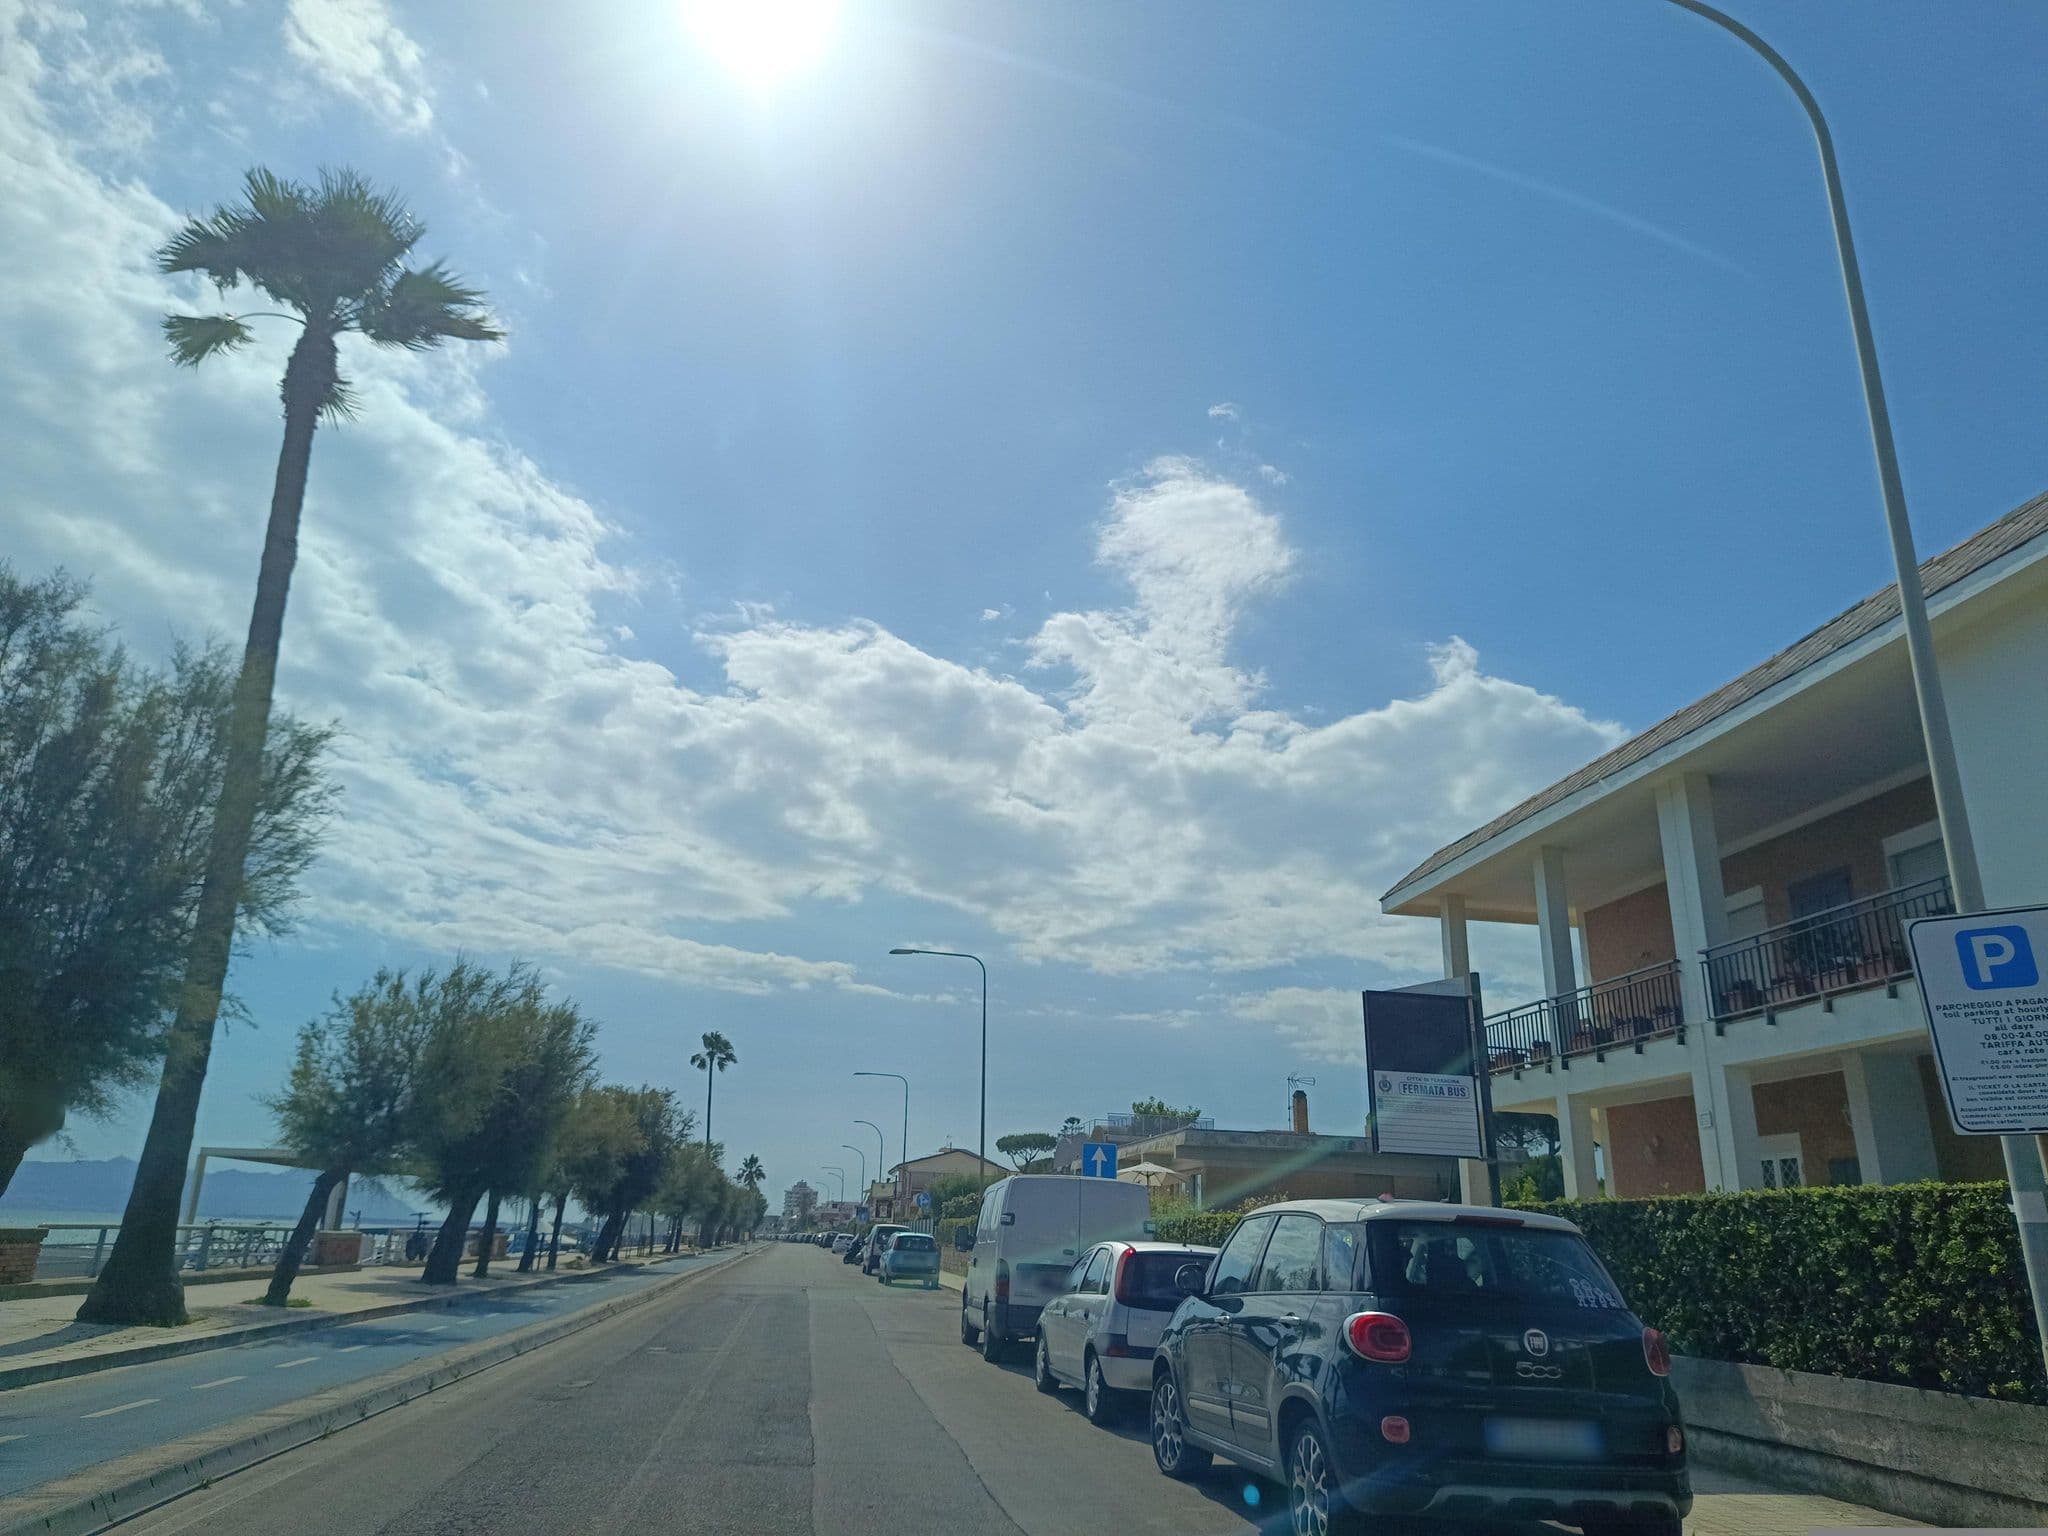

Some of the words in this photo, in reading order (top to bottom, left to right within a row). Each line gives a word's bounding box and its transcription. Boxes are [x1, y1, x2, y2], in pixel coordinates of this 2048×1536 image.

[1970, 934, 2016, 982] P
[1935, 1000, 2003, 1012] PARCHEGGIO
[1964, 1009, 2000, 1018] parking
[1971, 1016, 2003, 1025] TUTTI
[1994, 1023, 2008, 1031] all
[2011, 1023, 2034, 1031] days
[1979, 1040, 2025, 1049] TARIFFA
[1997, 1047, 2020, 1056] car's
[1402, 1083, 1445, 1096] FERMATA
[1447, 1086, 1466, 1097] BUS
